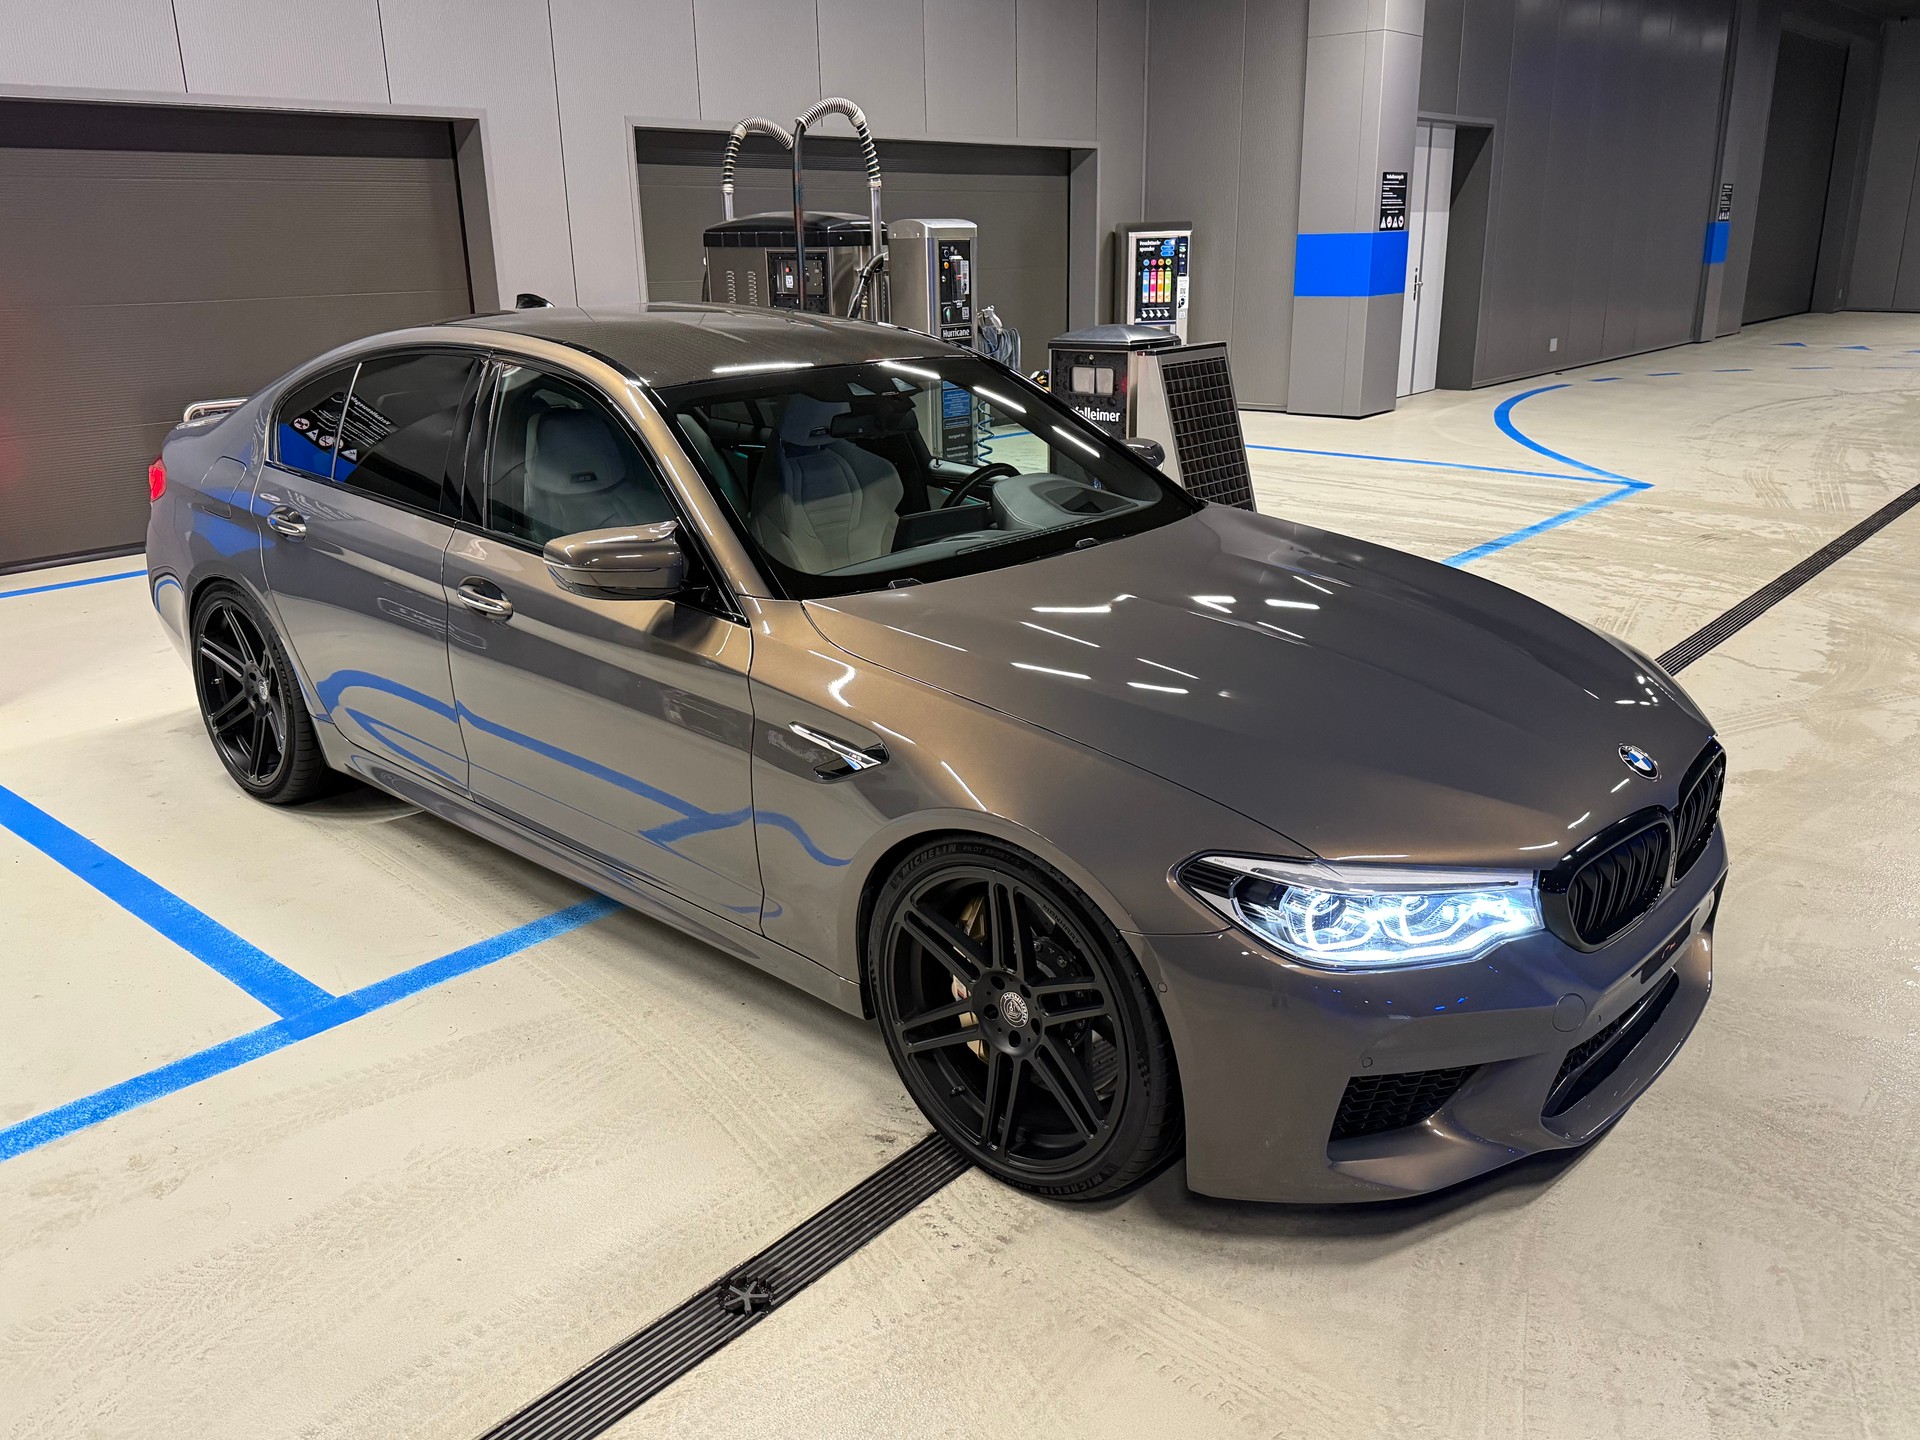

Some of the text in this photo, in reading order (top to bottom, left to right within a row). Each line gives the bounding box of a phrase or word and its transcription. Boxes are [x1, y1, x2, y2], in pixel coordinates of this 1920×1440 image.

[942, 327, 970, 338] Hurricane
[900, 843, 957, 880] MICHELIN
[962, 845, 984, 854] PILOT
[985, 848, 1010, 860] SPORT
[1043, 904, 1080, 944] MANHART
[1038, 1174, 1103, 1195] MICHELIN
